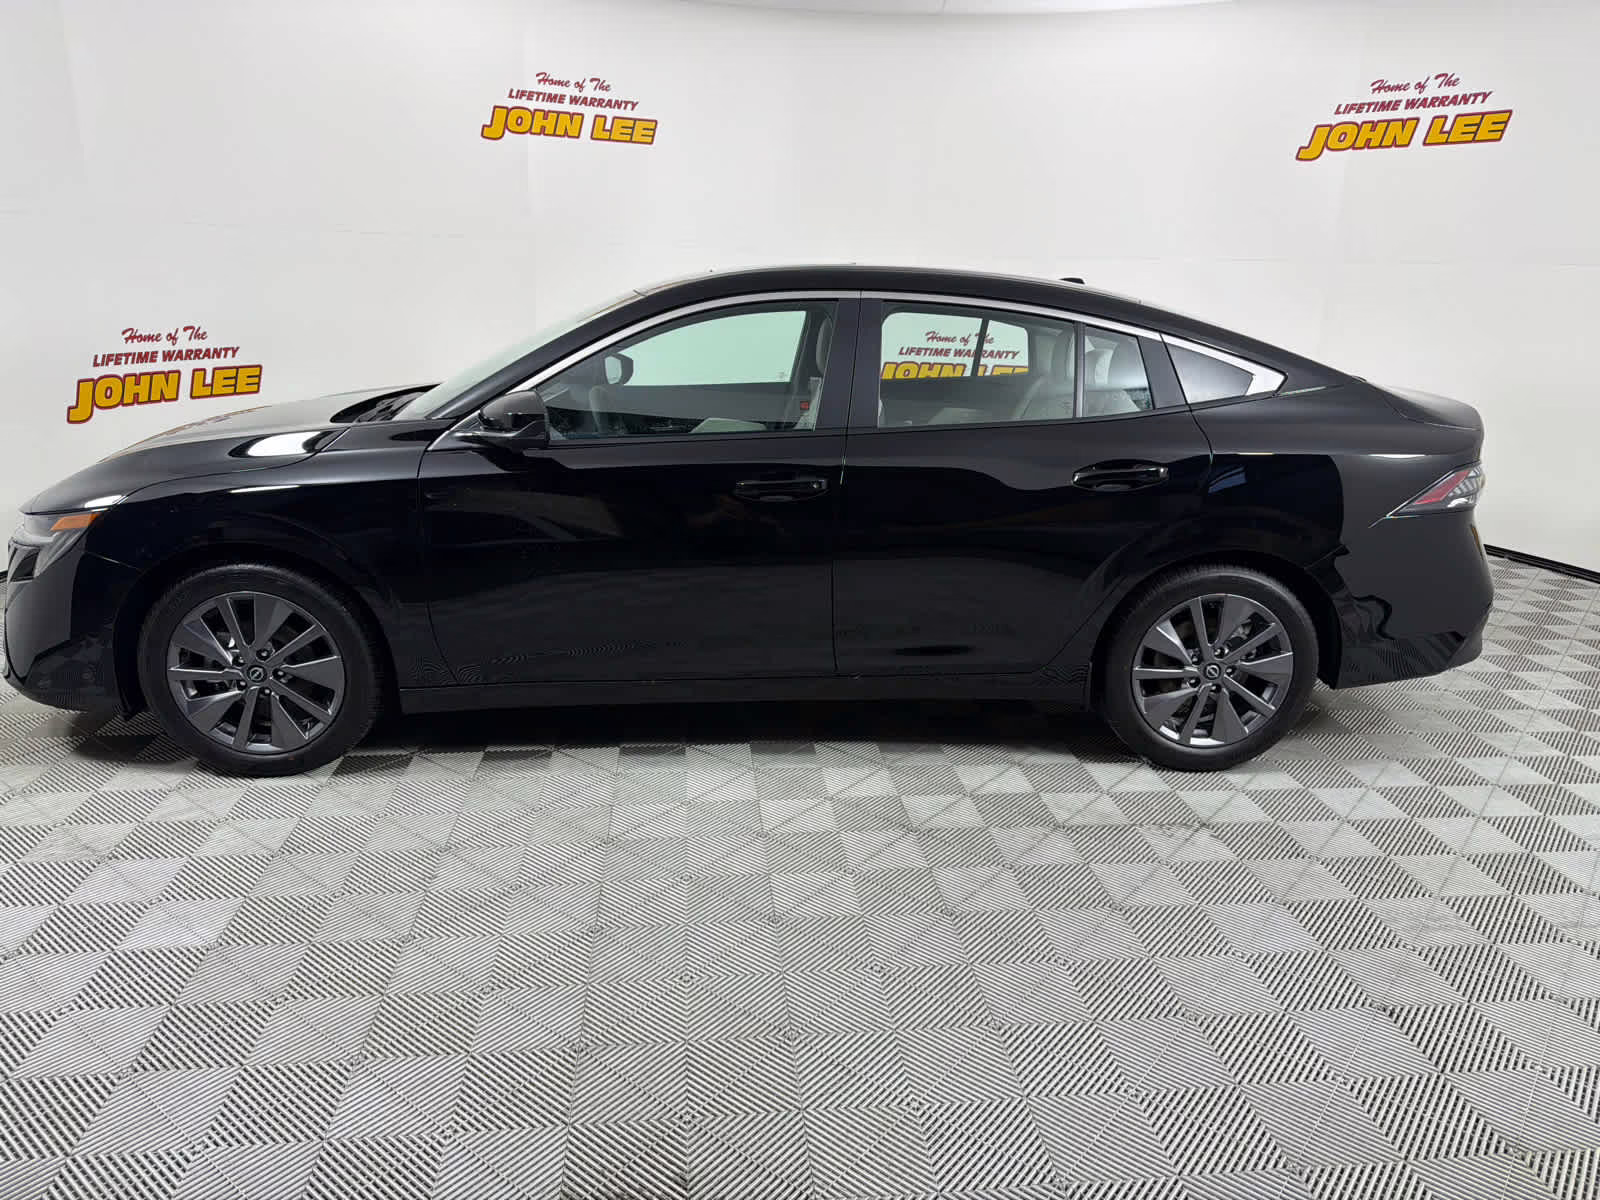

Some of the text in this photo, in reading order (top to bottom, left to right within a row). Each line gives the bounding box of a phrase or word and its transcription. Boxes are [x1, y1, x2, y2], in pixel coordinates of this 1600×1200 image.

[535, 72, 612, 93] Home of The
[1370, 73, 1461, 95] Home of The
[507, 88, 639, 111] LIFETIME WARRANTY
[1334, 91, 1493, 115] LIFETIME WARRANTY
[481, 105, 658, 145] JOHN LEE
[1295, 109, 1513, 161] JOHN LEE
[121, 325, 208, 346] Home of The
[925, 330, 956, 343] Home
[959, 333, 972, 346] of
[93, 346, 240, 367] LIFETIME WARRANTY
[898, 346, 952, 357] LIFETIME
[67, 364, 263, 424] JOHN LEE
